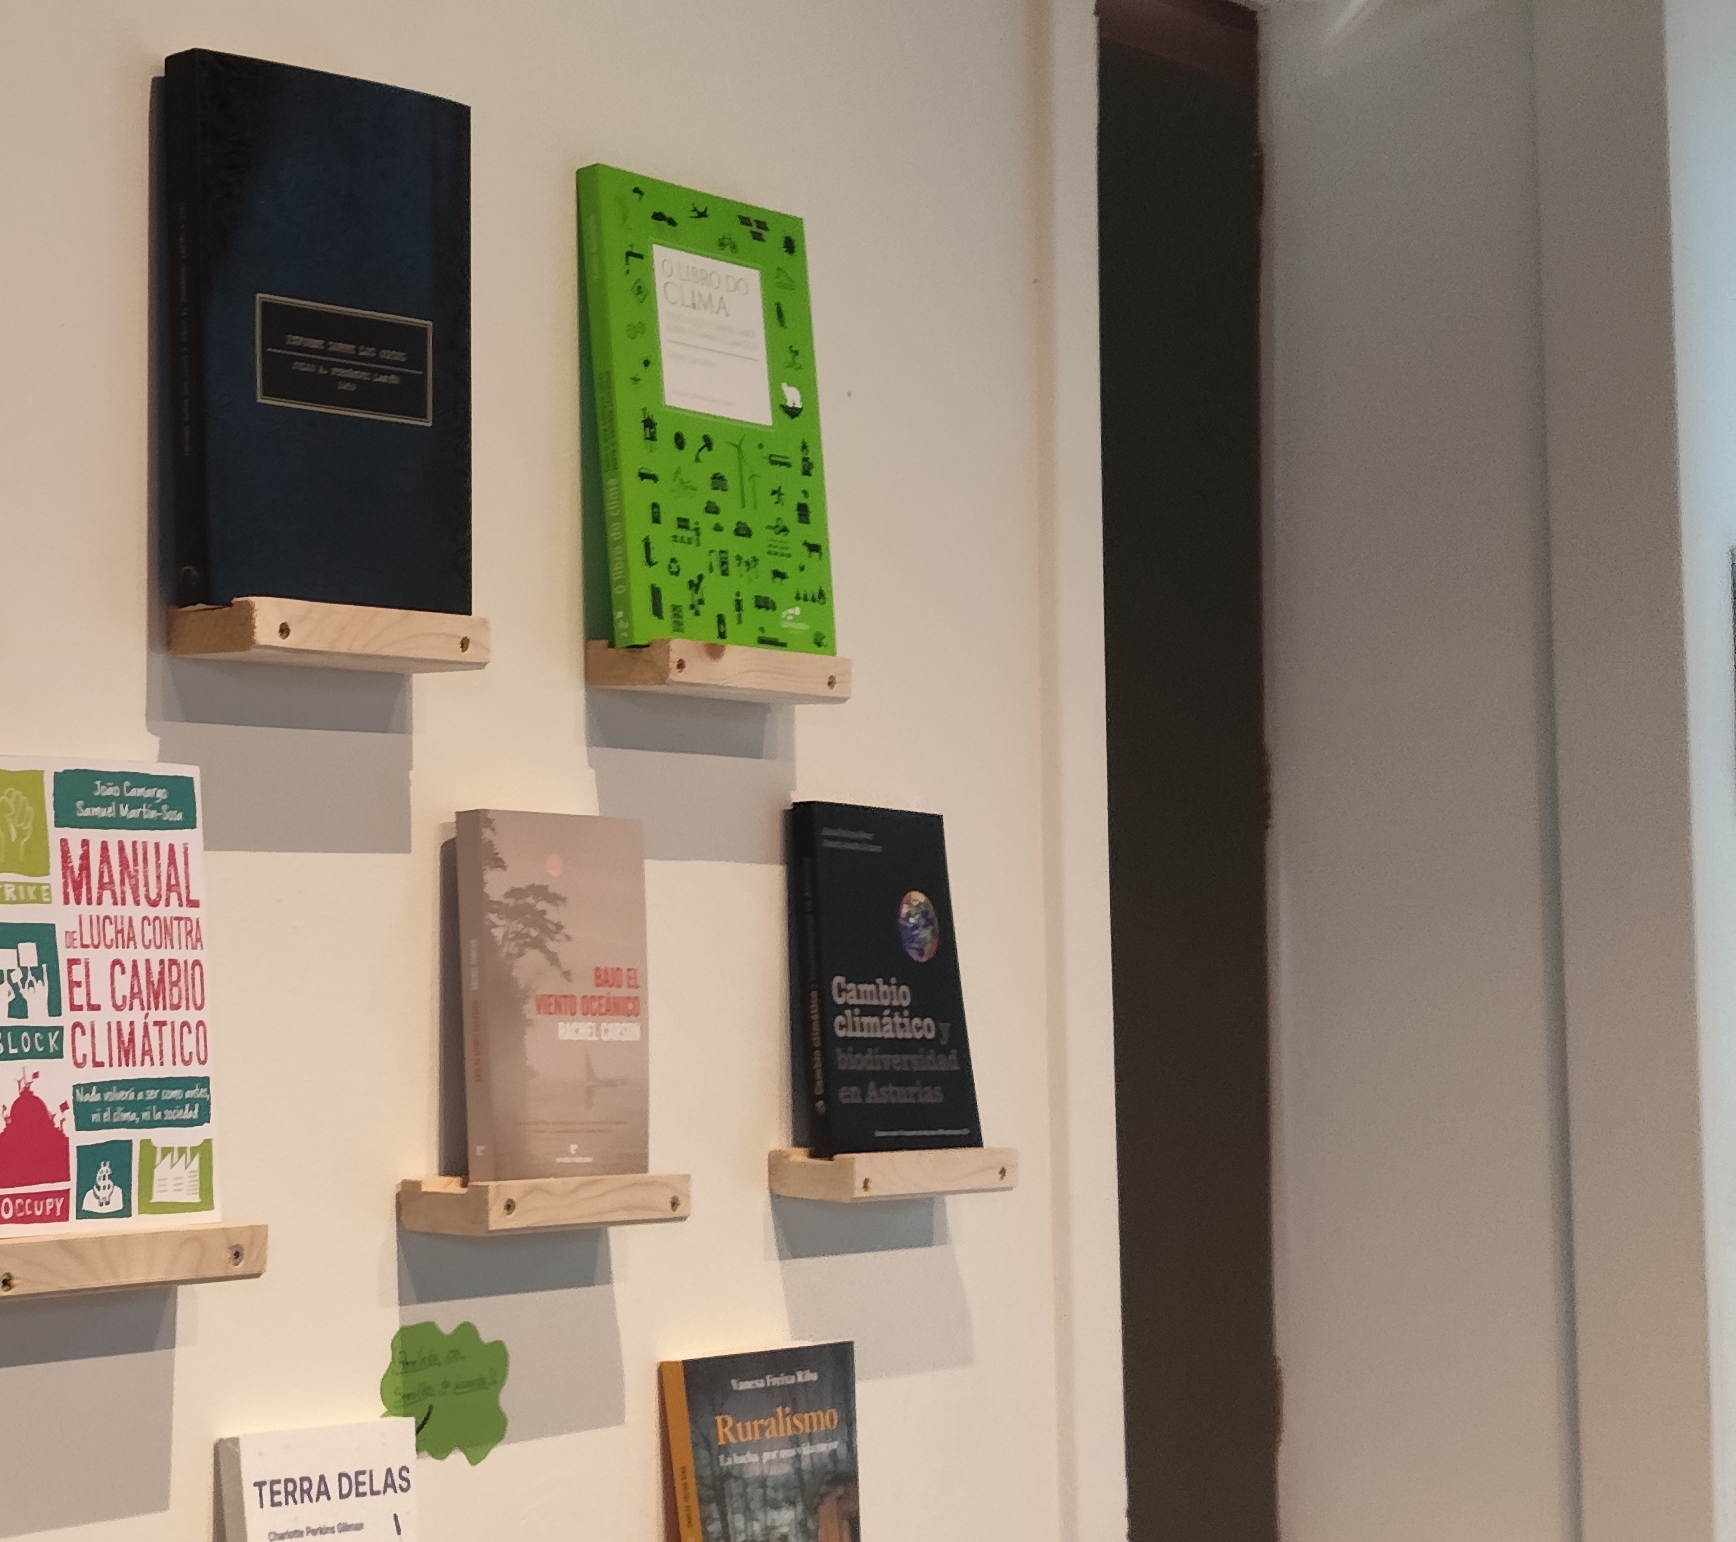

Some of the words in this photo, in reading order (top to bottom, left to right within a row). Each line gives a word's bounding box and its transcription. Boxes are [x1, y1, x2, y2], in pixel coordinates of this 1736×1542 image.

[661, 258, 674, 278] O
[678, 262, 721, 290] LIBRO
[725, 274, 750, 297] DO
[663, 281, 730, 318] CLIMA
[92, 780, 120, 797] João
[75, 800, 116, 818] Samuel
[59, 838, 201, 909] MANUAL
[65, 930, 78, 949] DE
[78, 914, 138, 950] LUCHA
[141, 916, 204, 951] CONTRA
[66, 958, 102, 1012] EL
[109, 958, 206, 1012] CAMBIO
[831, 976, 912, 1007] Cambio
[70, 1012, 209, 1069] CLIMÁTICO
[834, 1008, 936, 1039] climático
[835, 1047, 961, 1071] biodiversidad
[75, 1086, 102, 1102] Nada
[838, 1085, 863, 1104] en
[865, 1080, 945, 1104] Asturias
[0, 1196, 64, 1220] OCCUPY
[714, 1405, 840, 1446] Ruralismo
[253, 1473, 331, 1509] TERRA
[337, 1465, 412, 1501] DELAS
